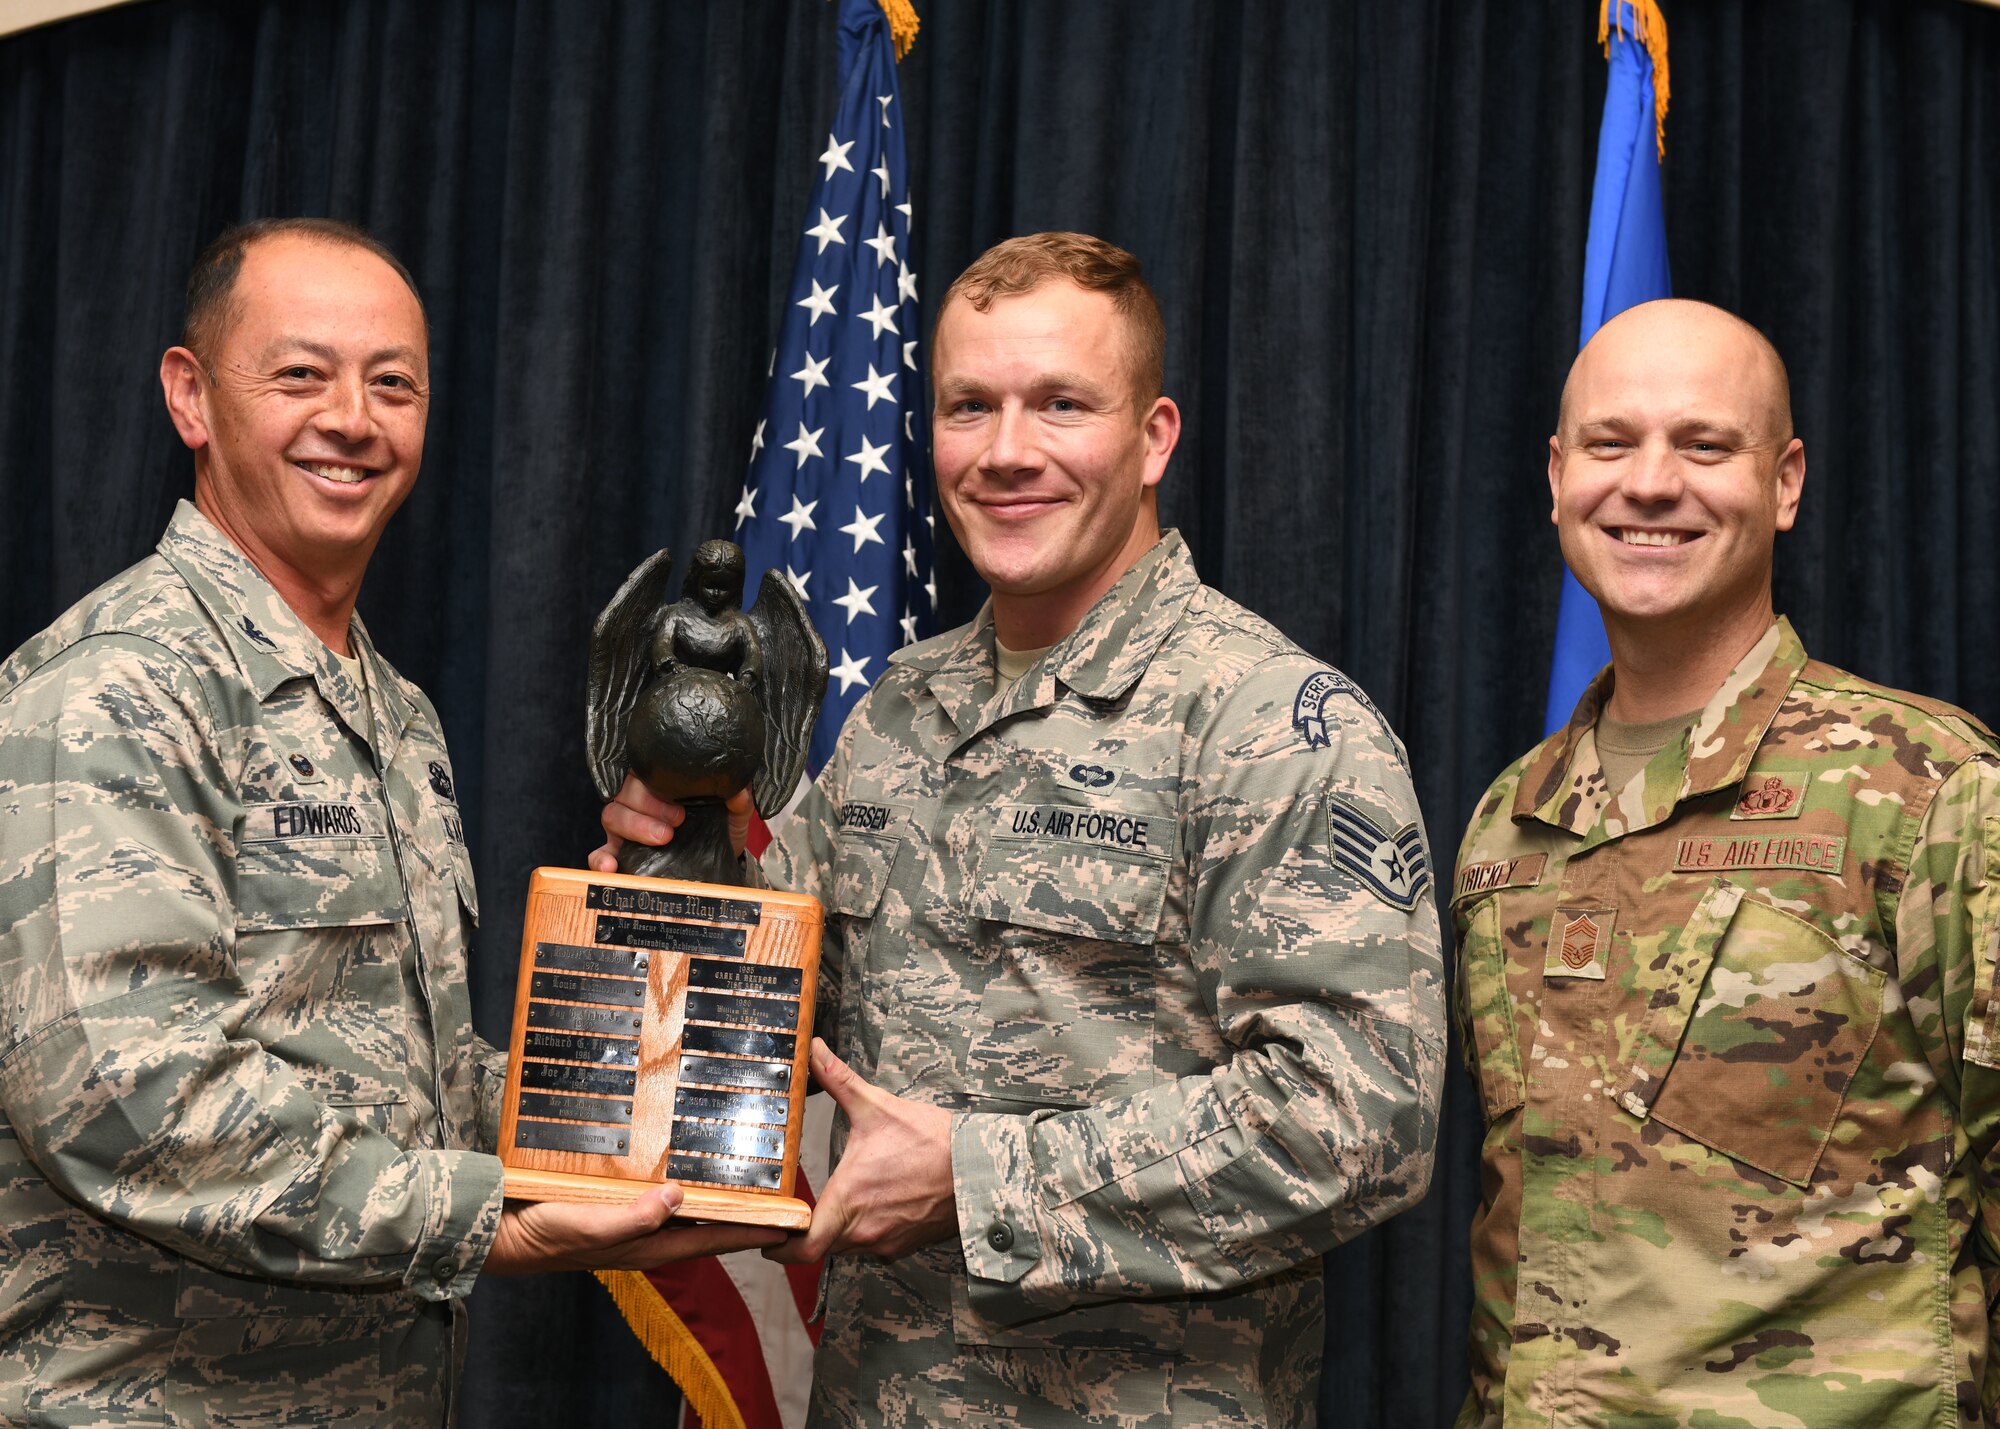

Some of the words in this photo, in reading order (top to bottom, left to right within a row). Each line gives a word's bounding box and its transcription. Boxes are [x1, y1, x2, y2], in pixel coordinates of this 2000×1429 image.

[1302, 677, 1329, 710] SERE
[273, 804, 361, 838] EDWARDS
[840, 804, 891, 830] SPERSEN
[1012, 810, 1040, 833] U.S.
[1043, 811, 1074, 837] AIR
[1075, 813, 1148, 847] FORCE
[1678, 840, 1714, 866] U.S.
[1722, 840, 1760, 866] AIR
[1763, 838, 1837, 869] FORCE
[1460, 860, 1519, 894] TRICKEY
[602, 887, 634, 909] That
[637, 890, 682, 915] Others
[686, 895, 715, 920] May
[719, 899, 748, 920] Live
[618, 918, 629, 929] Air
[633, 920, 656, 932] Rescue
[659, 923, 700, 937] Association
[702, 928, 724, 940] Award
[665, 930, 674, 940] for
[626, 934, 669, 950] Outstanding
[672, 940, 715, 953] Achievement
[552, 975, 577, 990] Louis
[533, 1033, 572, 1048] Richard
[575, 1051, 591, 1060] 1981
[540, 1064, 559, 1078] Joe
[571, 1080, 588, 1090] 1982
